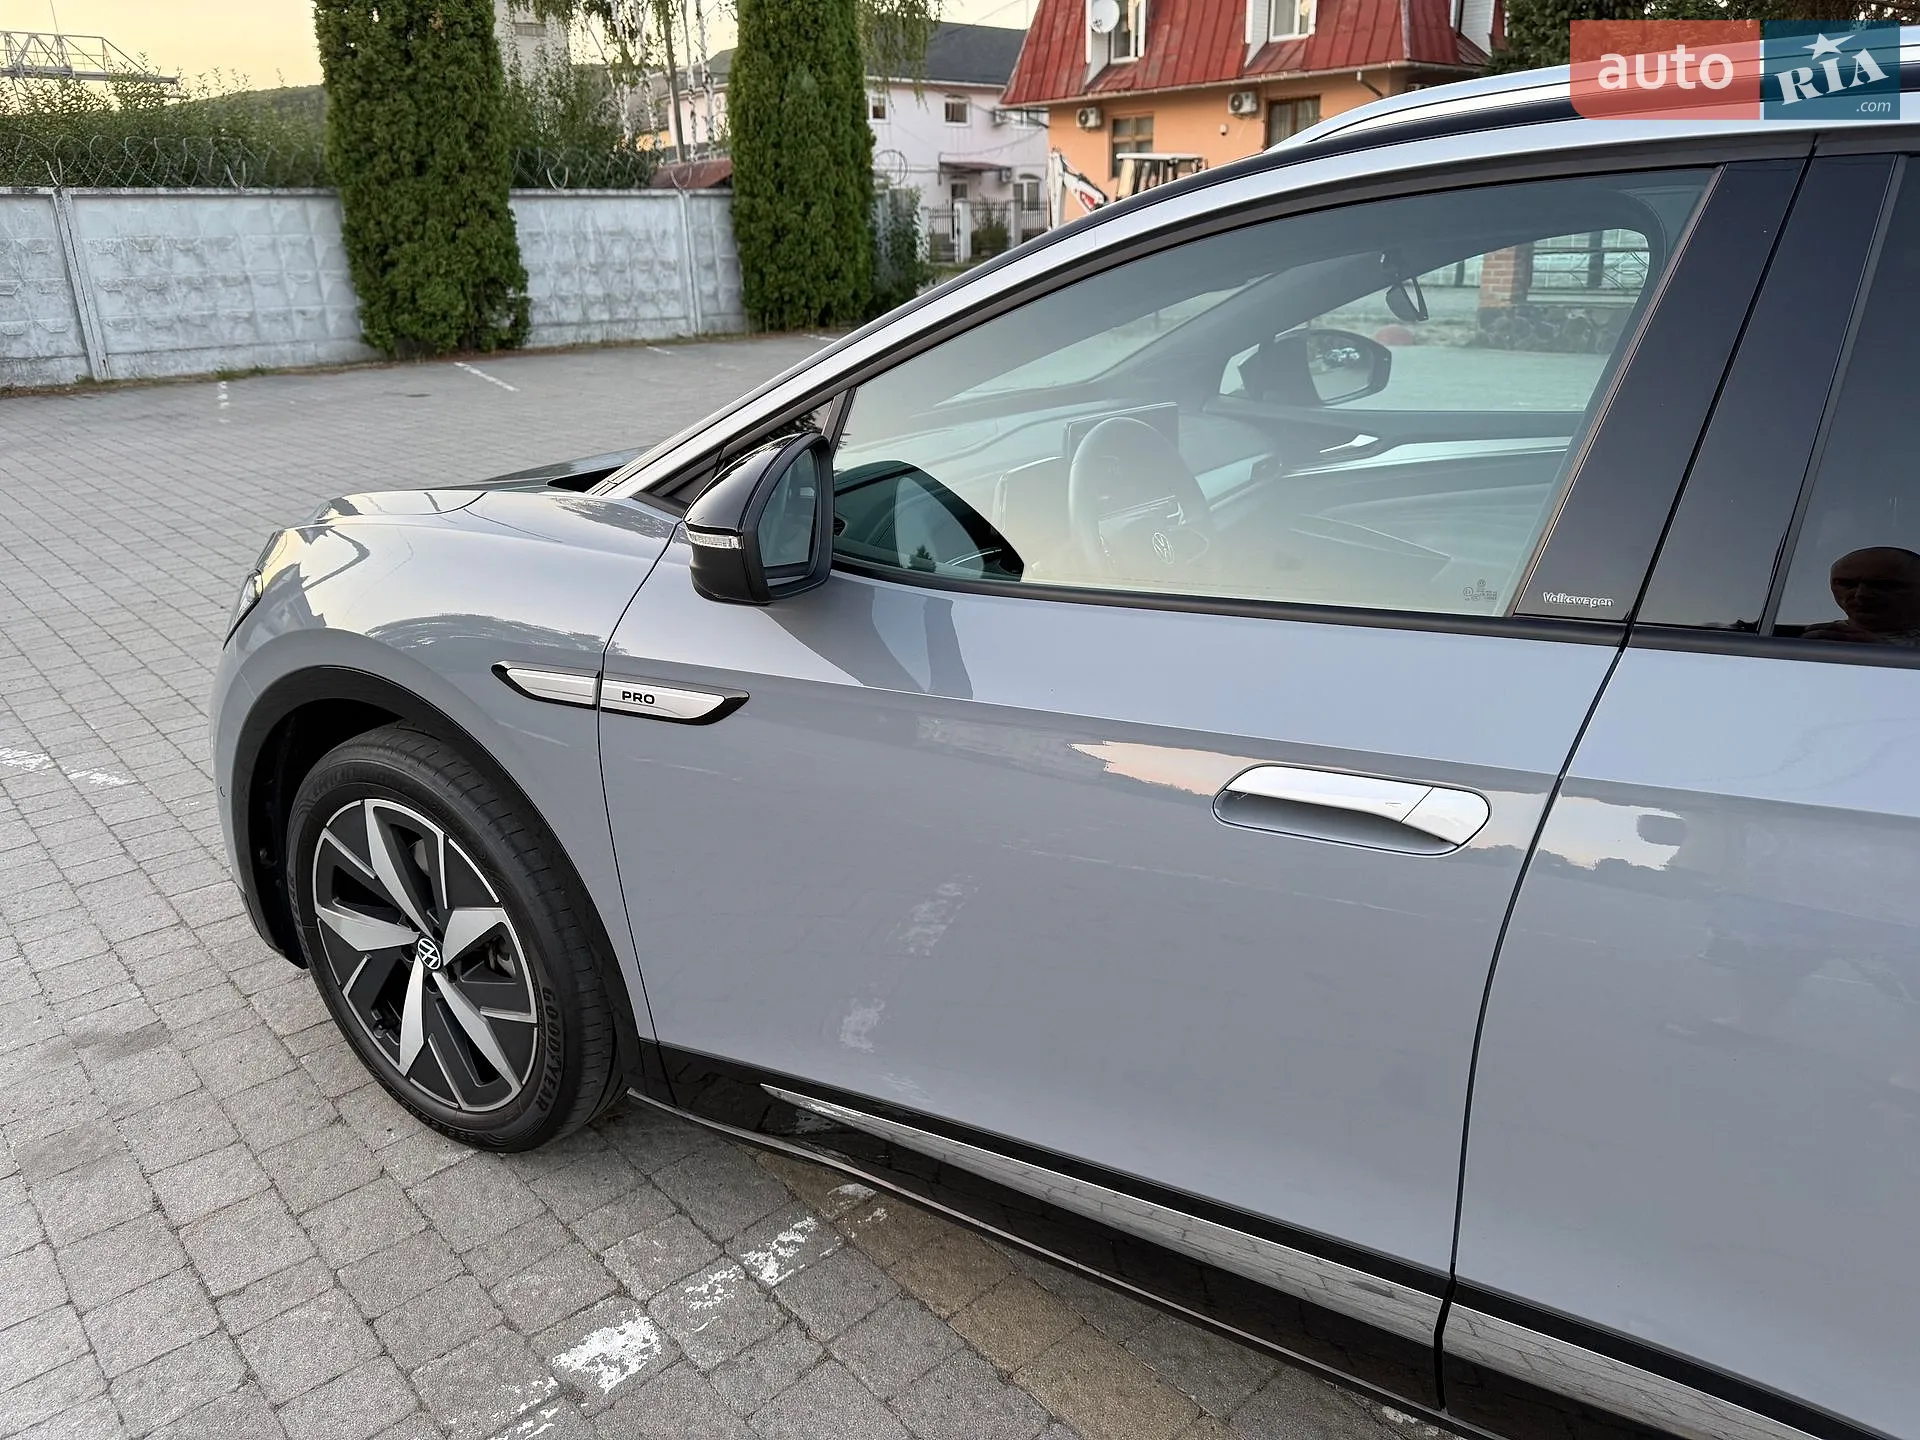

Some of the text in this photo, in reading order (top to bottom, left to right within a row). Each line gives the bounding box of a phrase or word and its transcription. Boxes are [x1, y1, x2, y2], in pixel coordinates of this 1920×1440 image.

[1542, 591, 1615, 608] Volkswagen
[621, 690, 656, 705] PRO
[535, 986, 562, 1112] GOODYEAR
